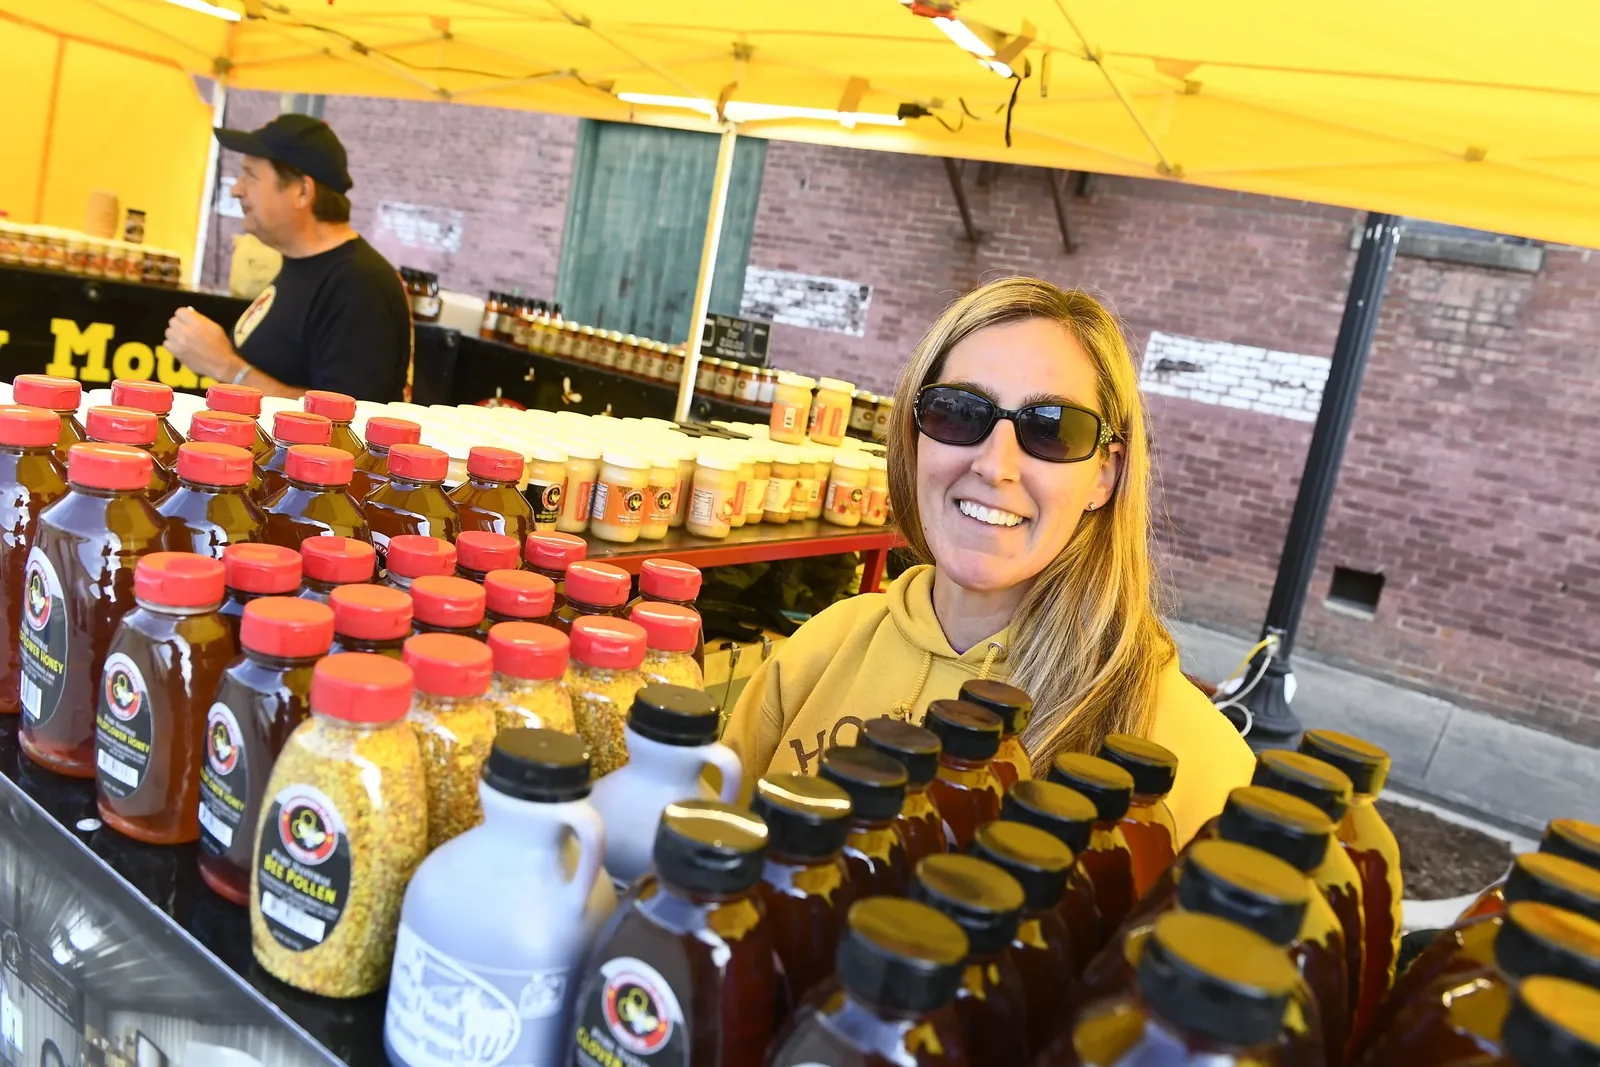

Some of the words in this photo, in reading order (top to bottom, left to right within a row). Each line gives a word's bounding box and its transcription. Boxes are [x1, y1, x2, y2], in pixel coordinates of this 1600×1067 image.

[46, 317, 218, 389] Mou
[40, 652, 64, 675] HONEY
[127, 735, 150, 753] HONEY
[264, 853, 285, 880] BEE
[285, 867, 337, 904] POLLEN
